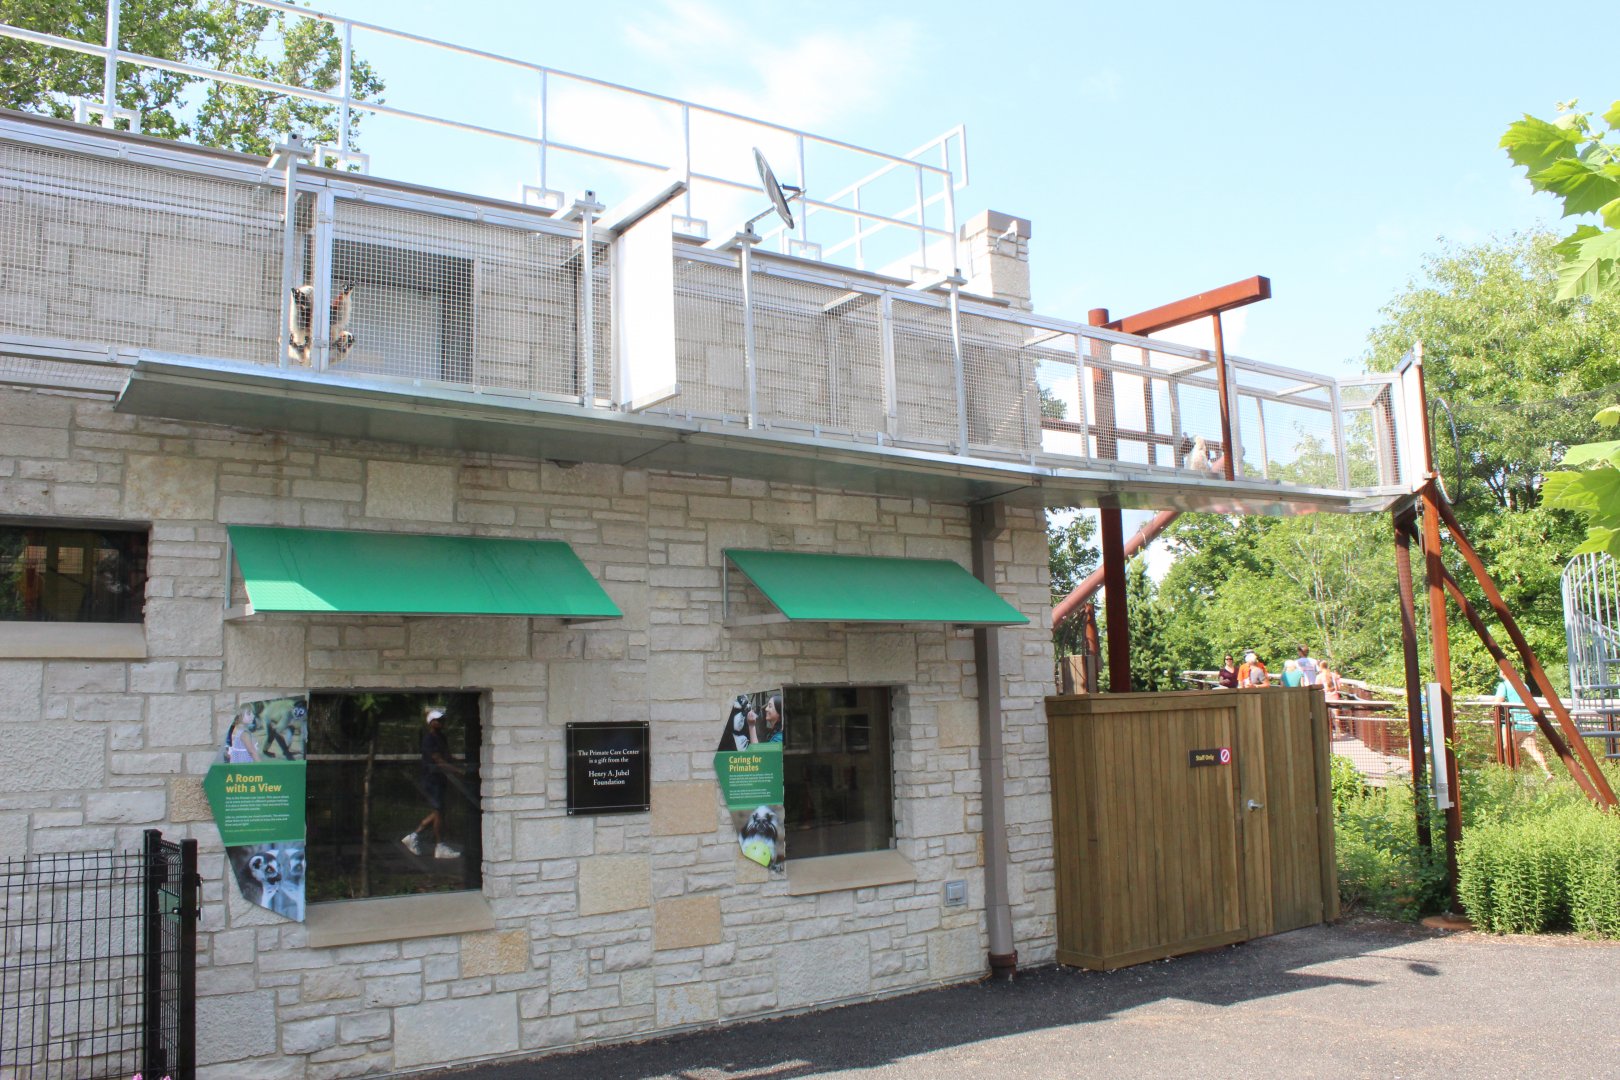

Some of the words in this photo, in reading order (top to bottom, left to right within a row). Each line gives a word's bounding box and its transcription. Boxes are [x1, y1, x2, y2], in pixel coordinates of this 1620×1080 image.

[598, 757, 607, 765] gift
[729, 756, 751, 765] Caring
[752, 755, 762, 763] for
[729, 764, 759, 772] Primates
[226, 774, 233, 783] A
[236, 773, 263, 783] Room
[588, 770, 606, 778] Henry
[226, 784, 247, 793] with
[258, 783, 282, 792] View
